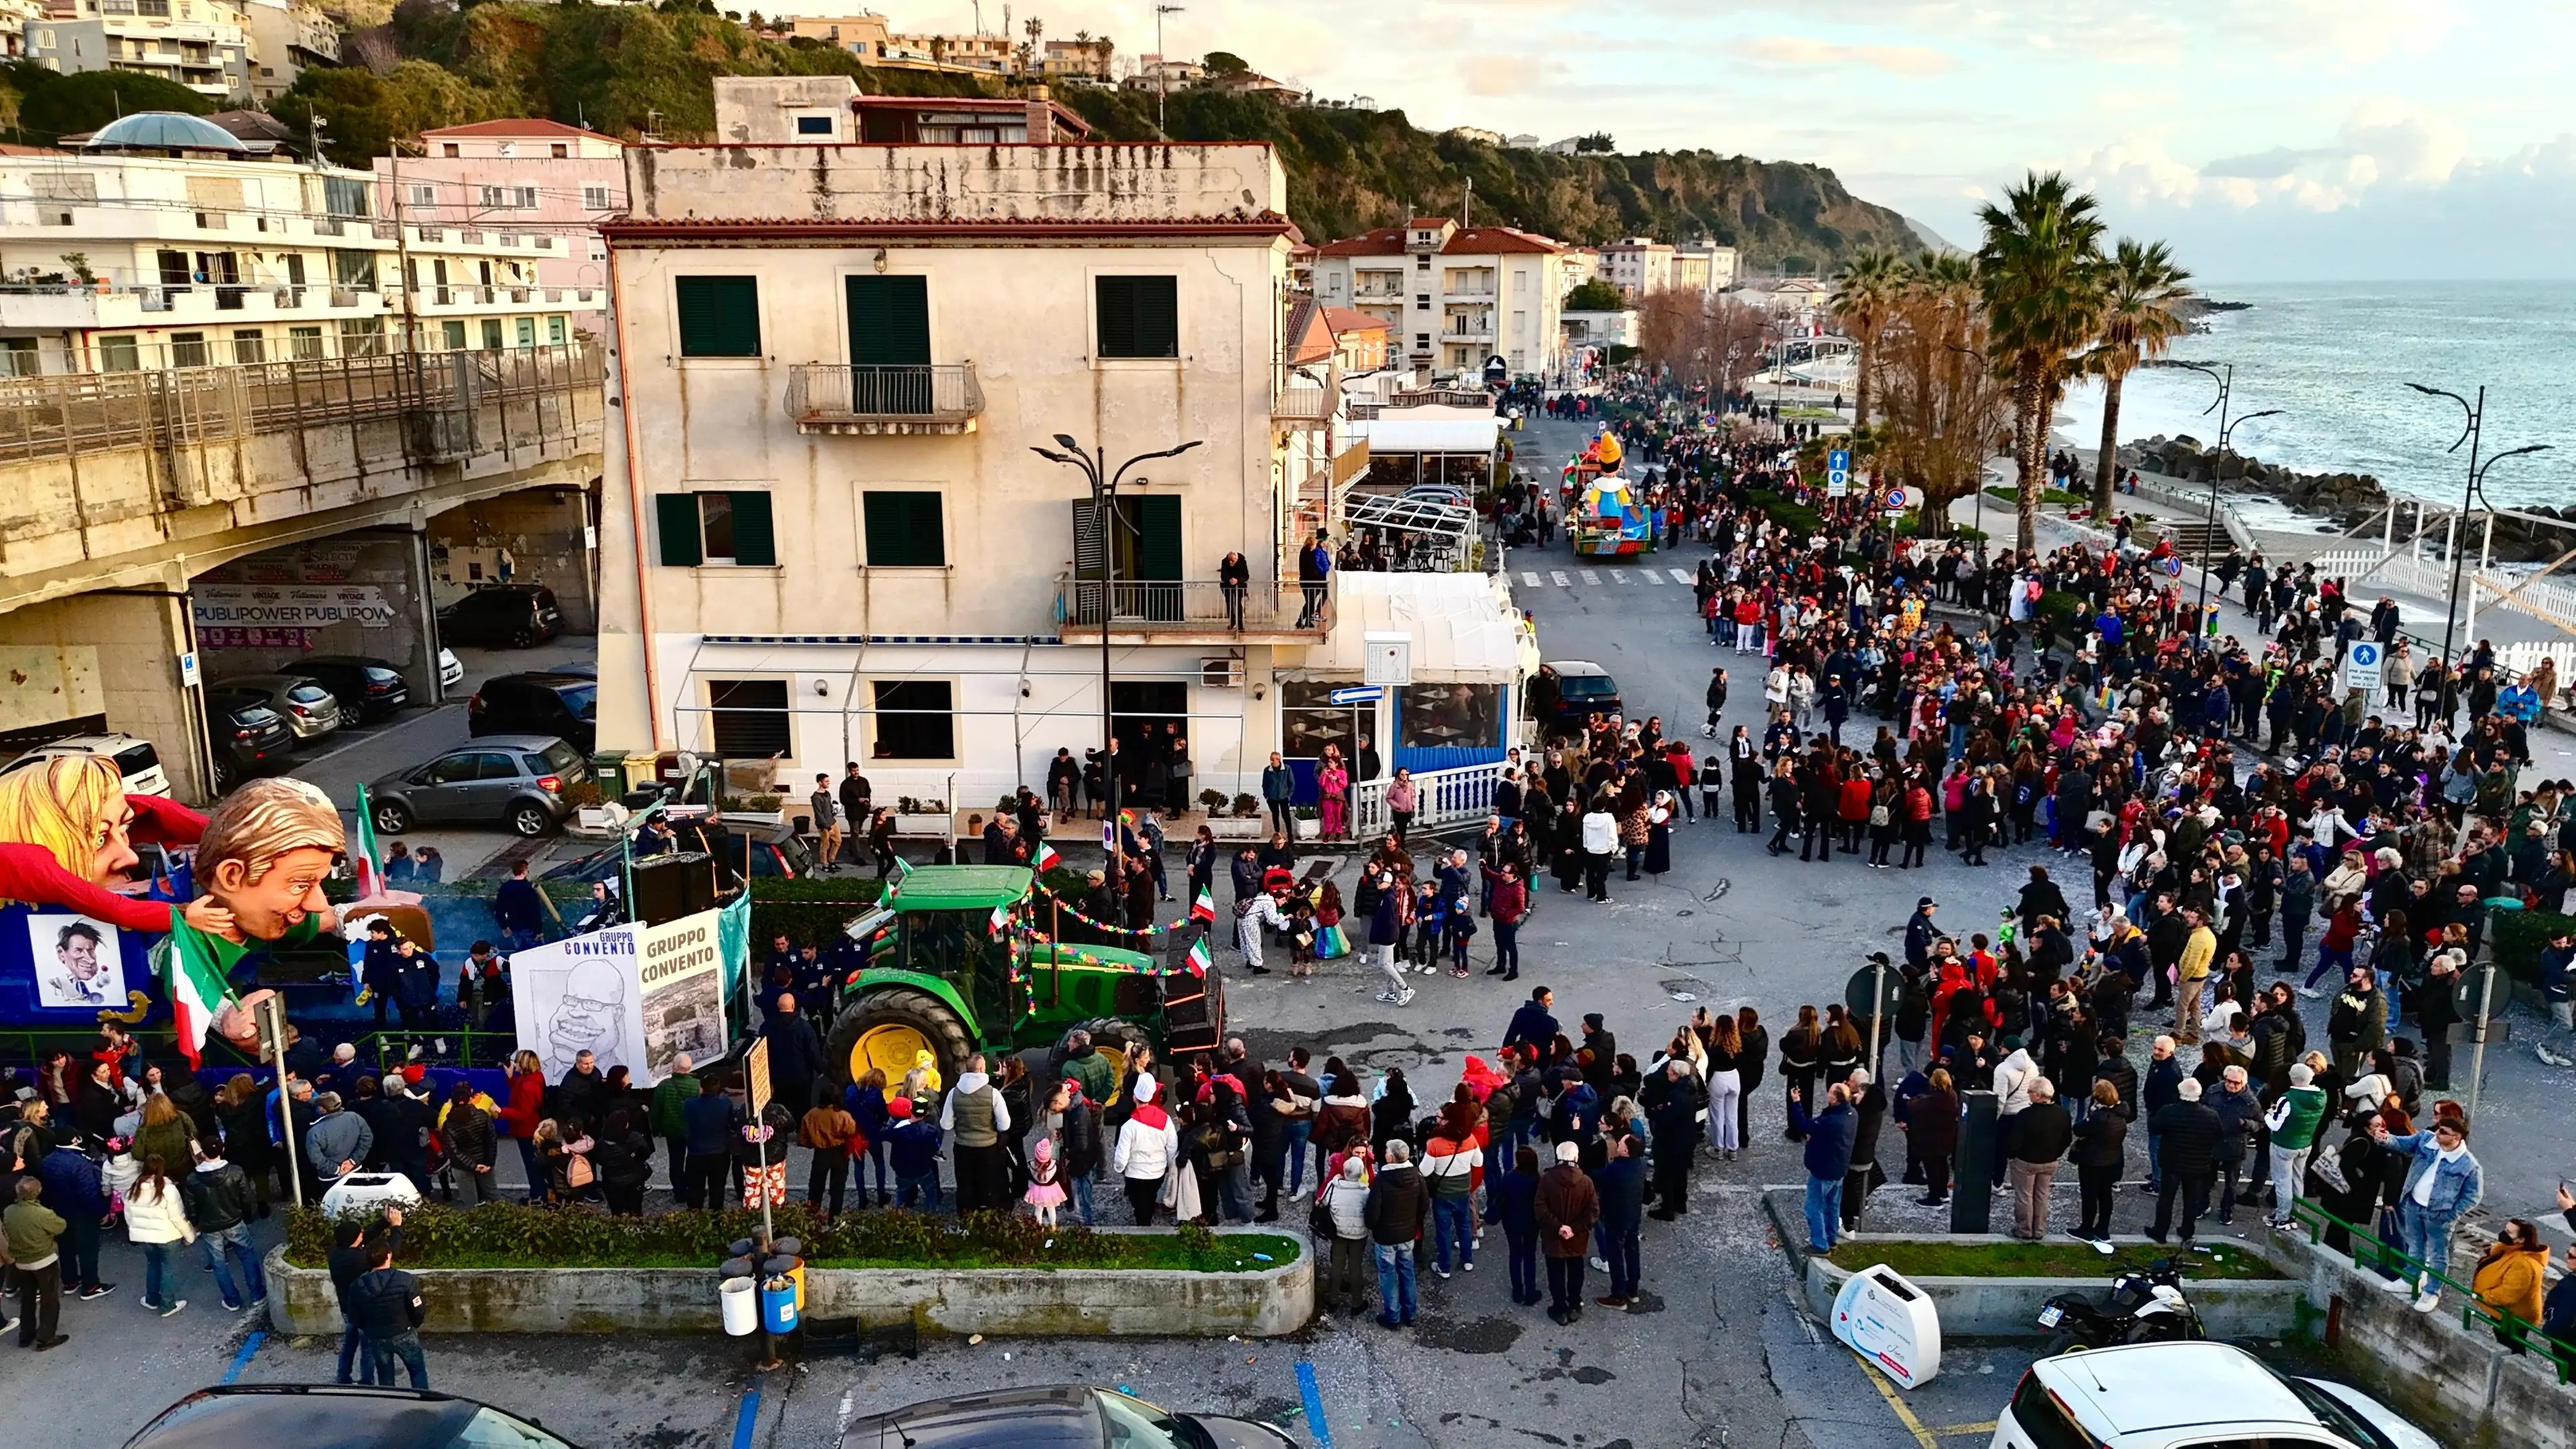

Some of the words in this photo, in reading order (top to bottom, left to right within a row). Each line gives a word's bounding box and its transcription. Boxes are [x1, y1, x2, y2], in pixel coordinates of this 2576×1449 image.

[194, 606, 301, 621] PUBLIPOWER
[599, 932, 633, 942] GRUPPO
[647, 926, 706, 958] GRUPPO
[564, 942, 635, 955] CONVENTO
[641, 946, 714, 983] CONVENTO
